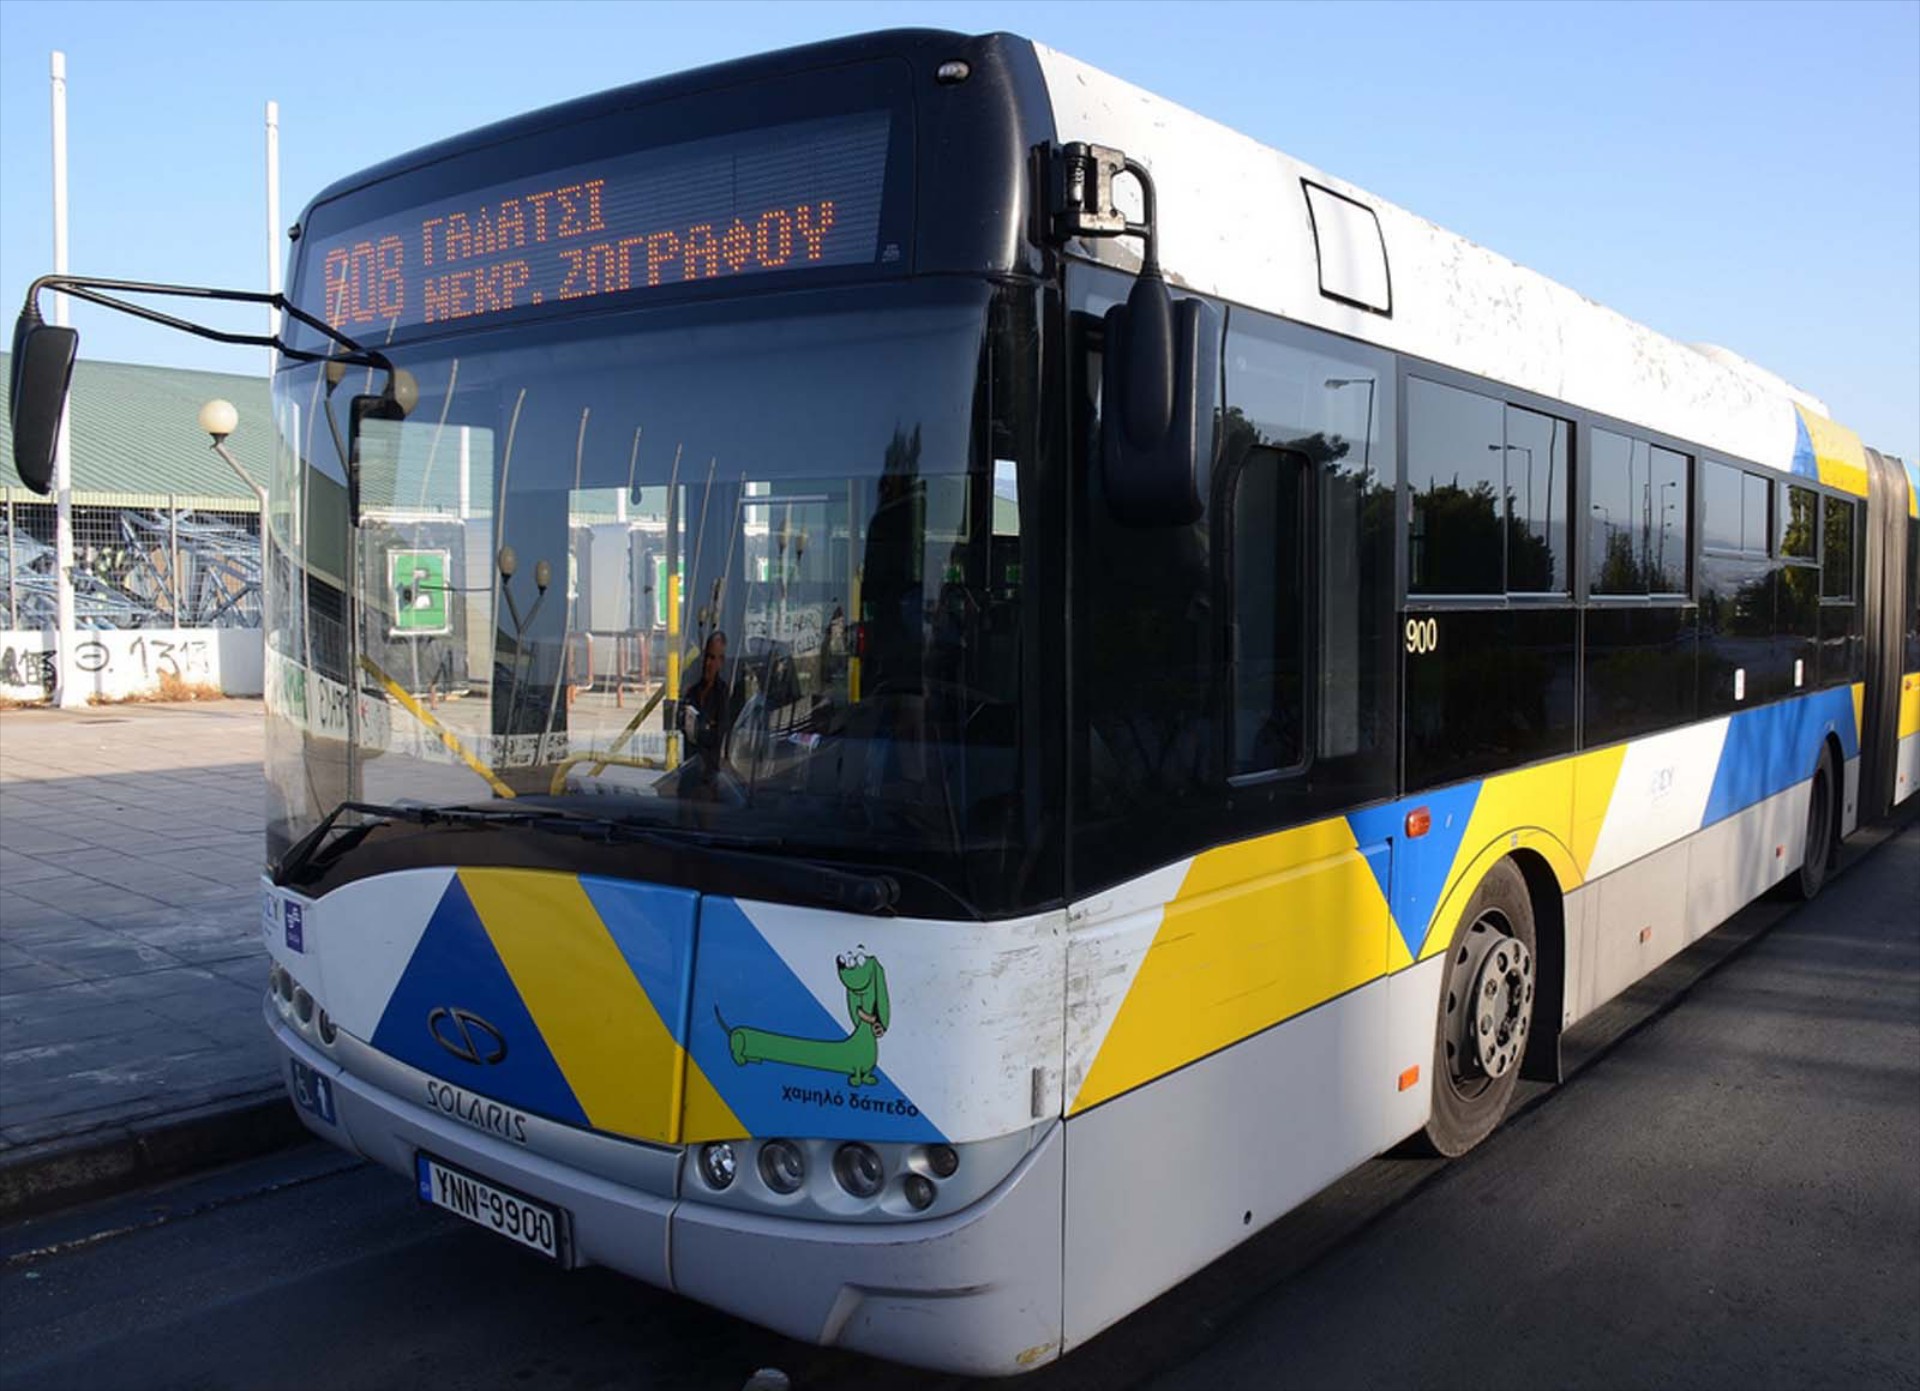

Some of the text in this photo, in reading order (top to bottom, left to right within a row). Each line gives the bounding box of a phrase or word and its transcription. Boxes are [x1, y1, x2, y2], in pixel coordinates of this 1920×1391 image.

[422, 179, 605, 267] ΓΑΛΑΤΣΙ
[559, 200, 834, 300] ΖΩΓΡΑΦΟΥ
[1406, 617, 1437, 655] 900
[427, 1081, 527, 1144] SOLARIS
[781, 1083, 919, 1118] χαμηλό δάπεδο
